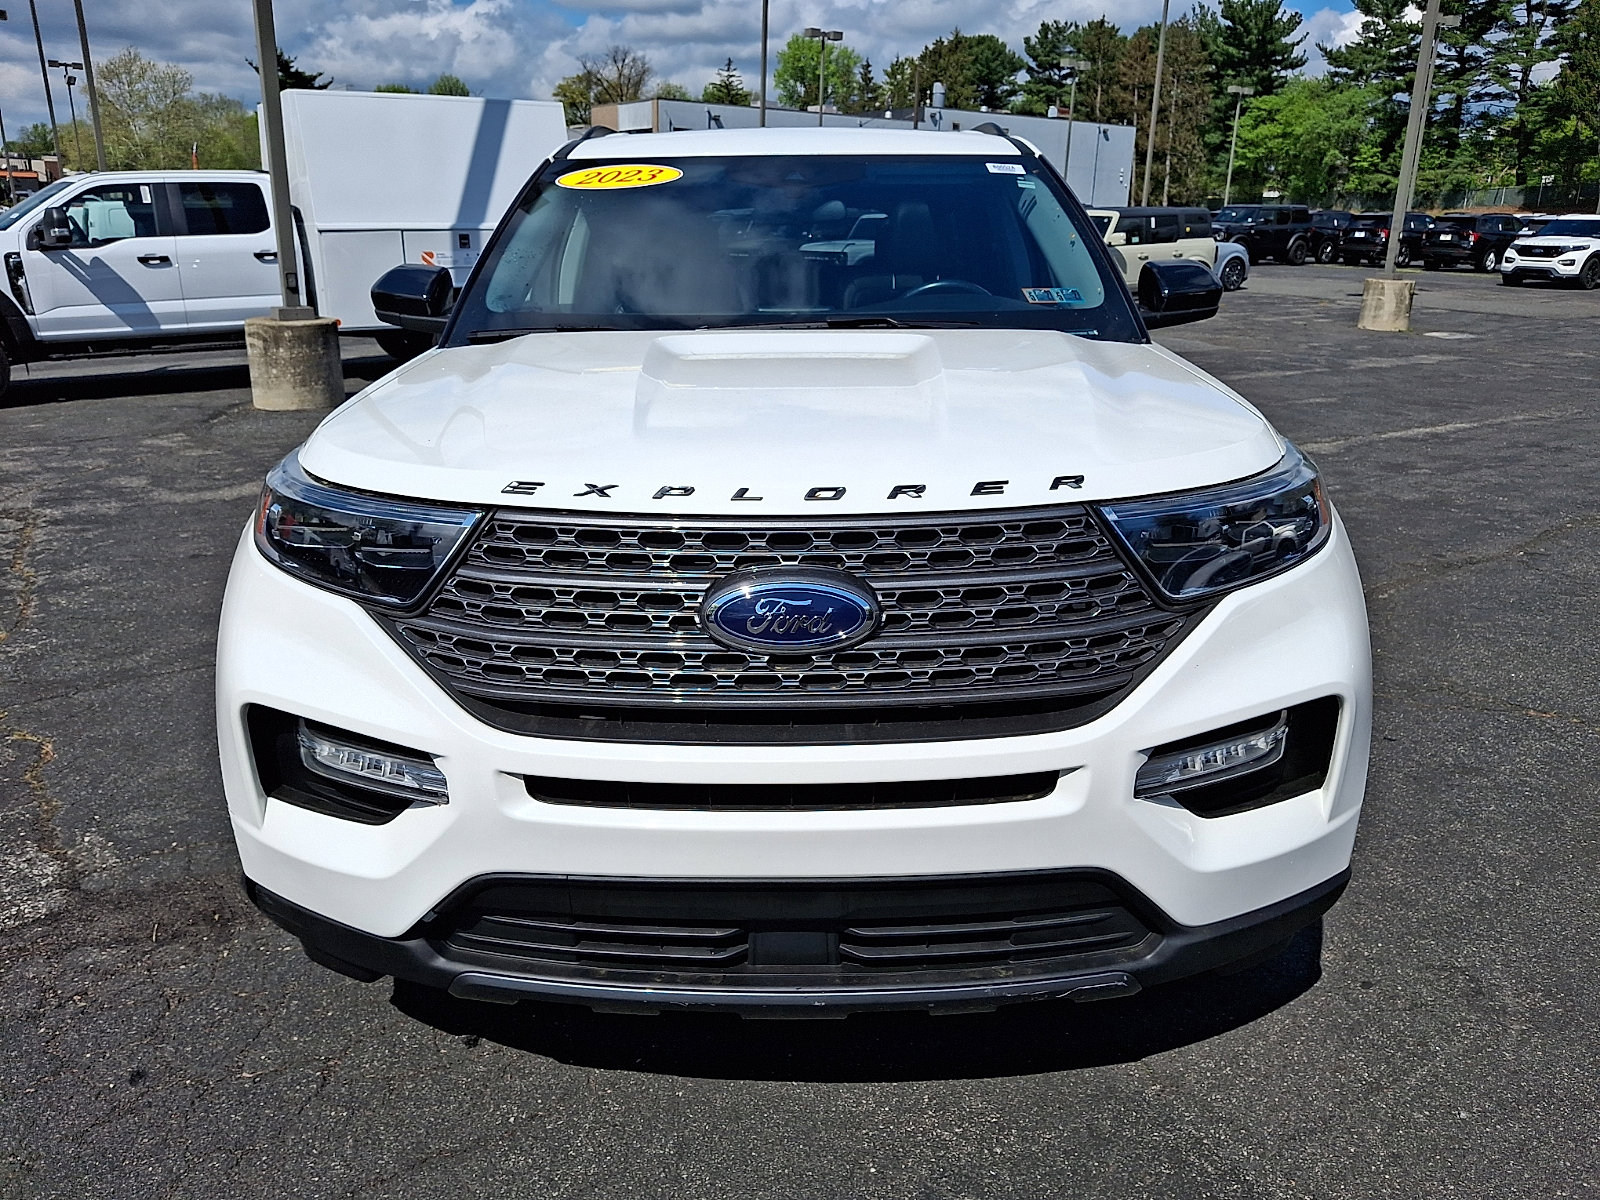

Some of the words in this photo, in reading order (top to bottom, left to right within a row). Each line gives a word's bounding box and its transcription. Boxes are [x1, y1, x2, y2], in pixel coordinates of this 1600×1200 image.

[575, 169, 664, 185] 2023
[501, 475, 1084, 501] EXPLORER
[746, 598, 833, 634] Ford
